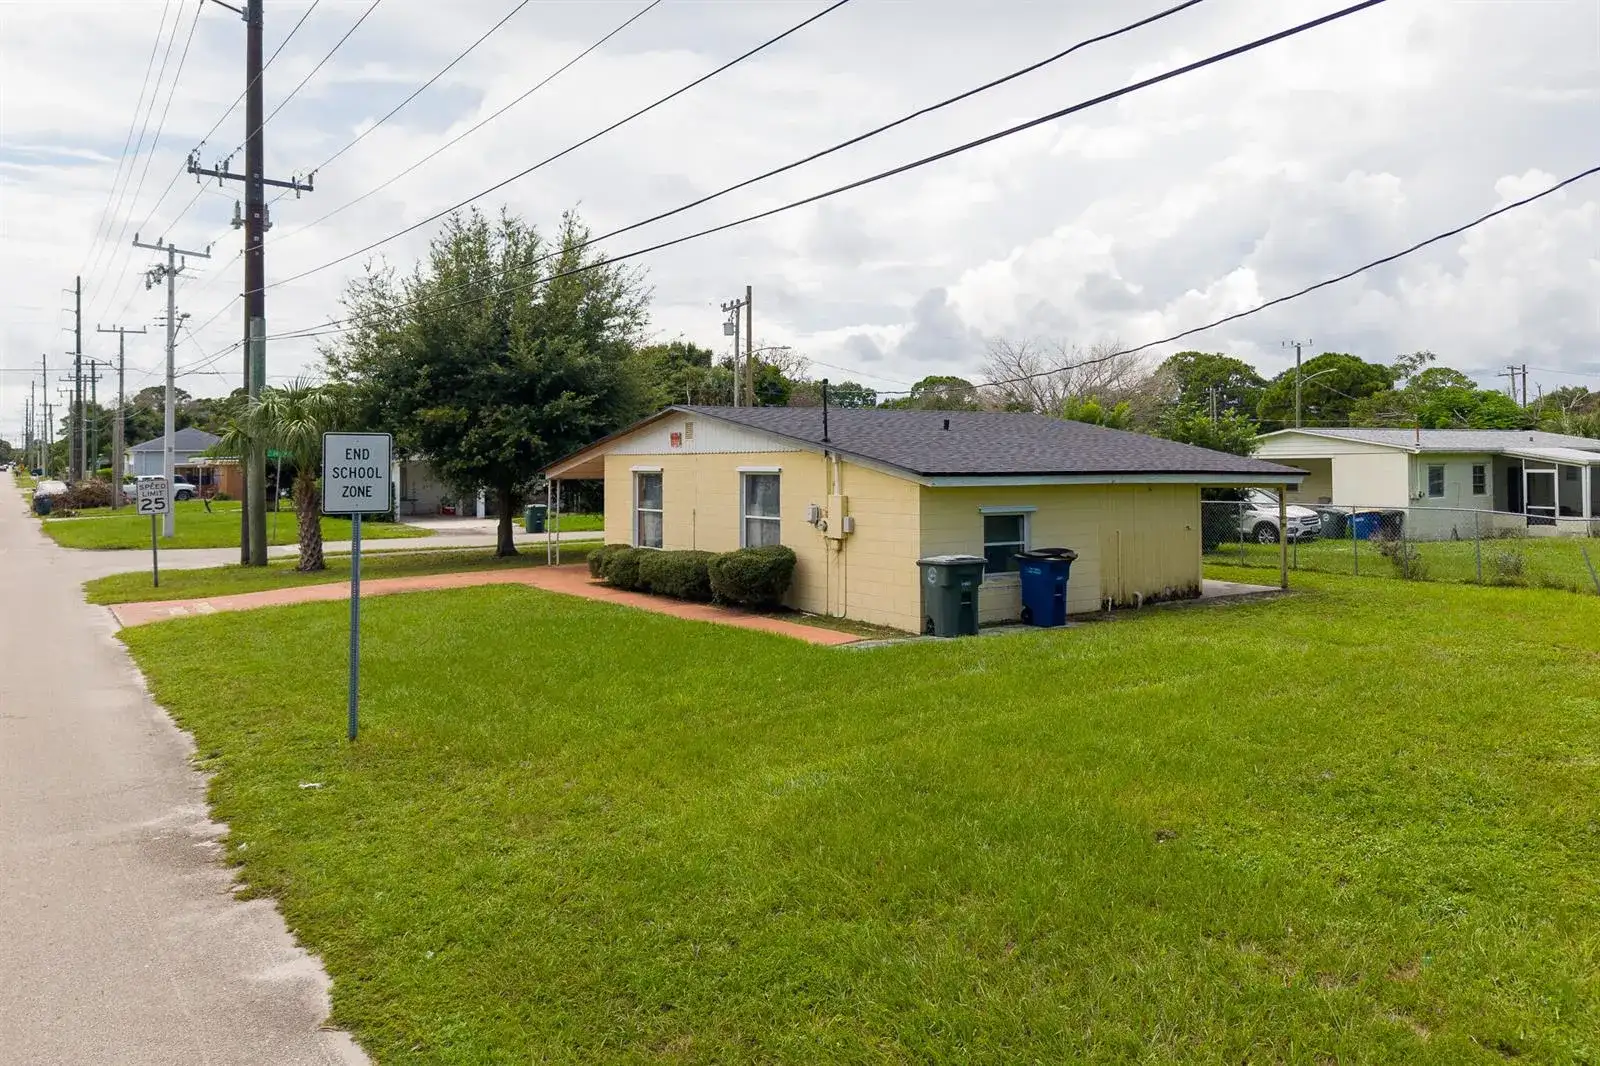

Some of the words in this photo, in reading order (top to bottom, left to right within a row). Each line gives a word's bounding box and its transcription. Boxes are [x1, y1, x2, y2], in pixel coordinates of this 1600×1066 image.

[345, 448, 370, 460] END
[332, 467, 382, 479] SCHOOL
[342, 486, 372, 498] ZONE
[141, 497, 166, 511] 25
